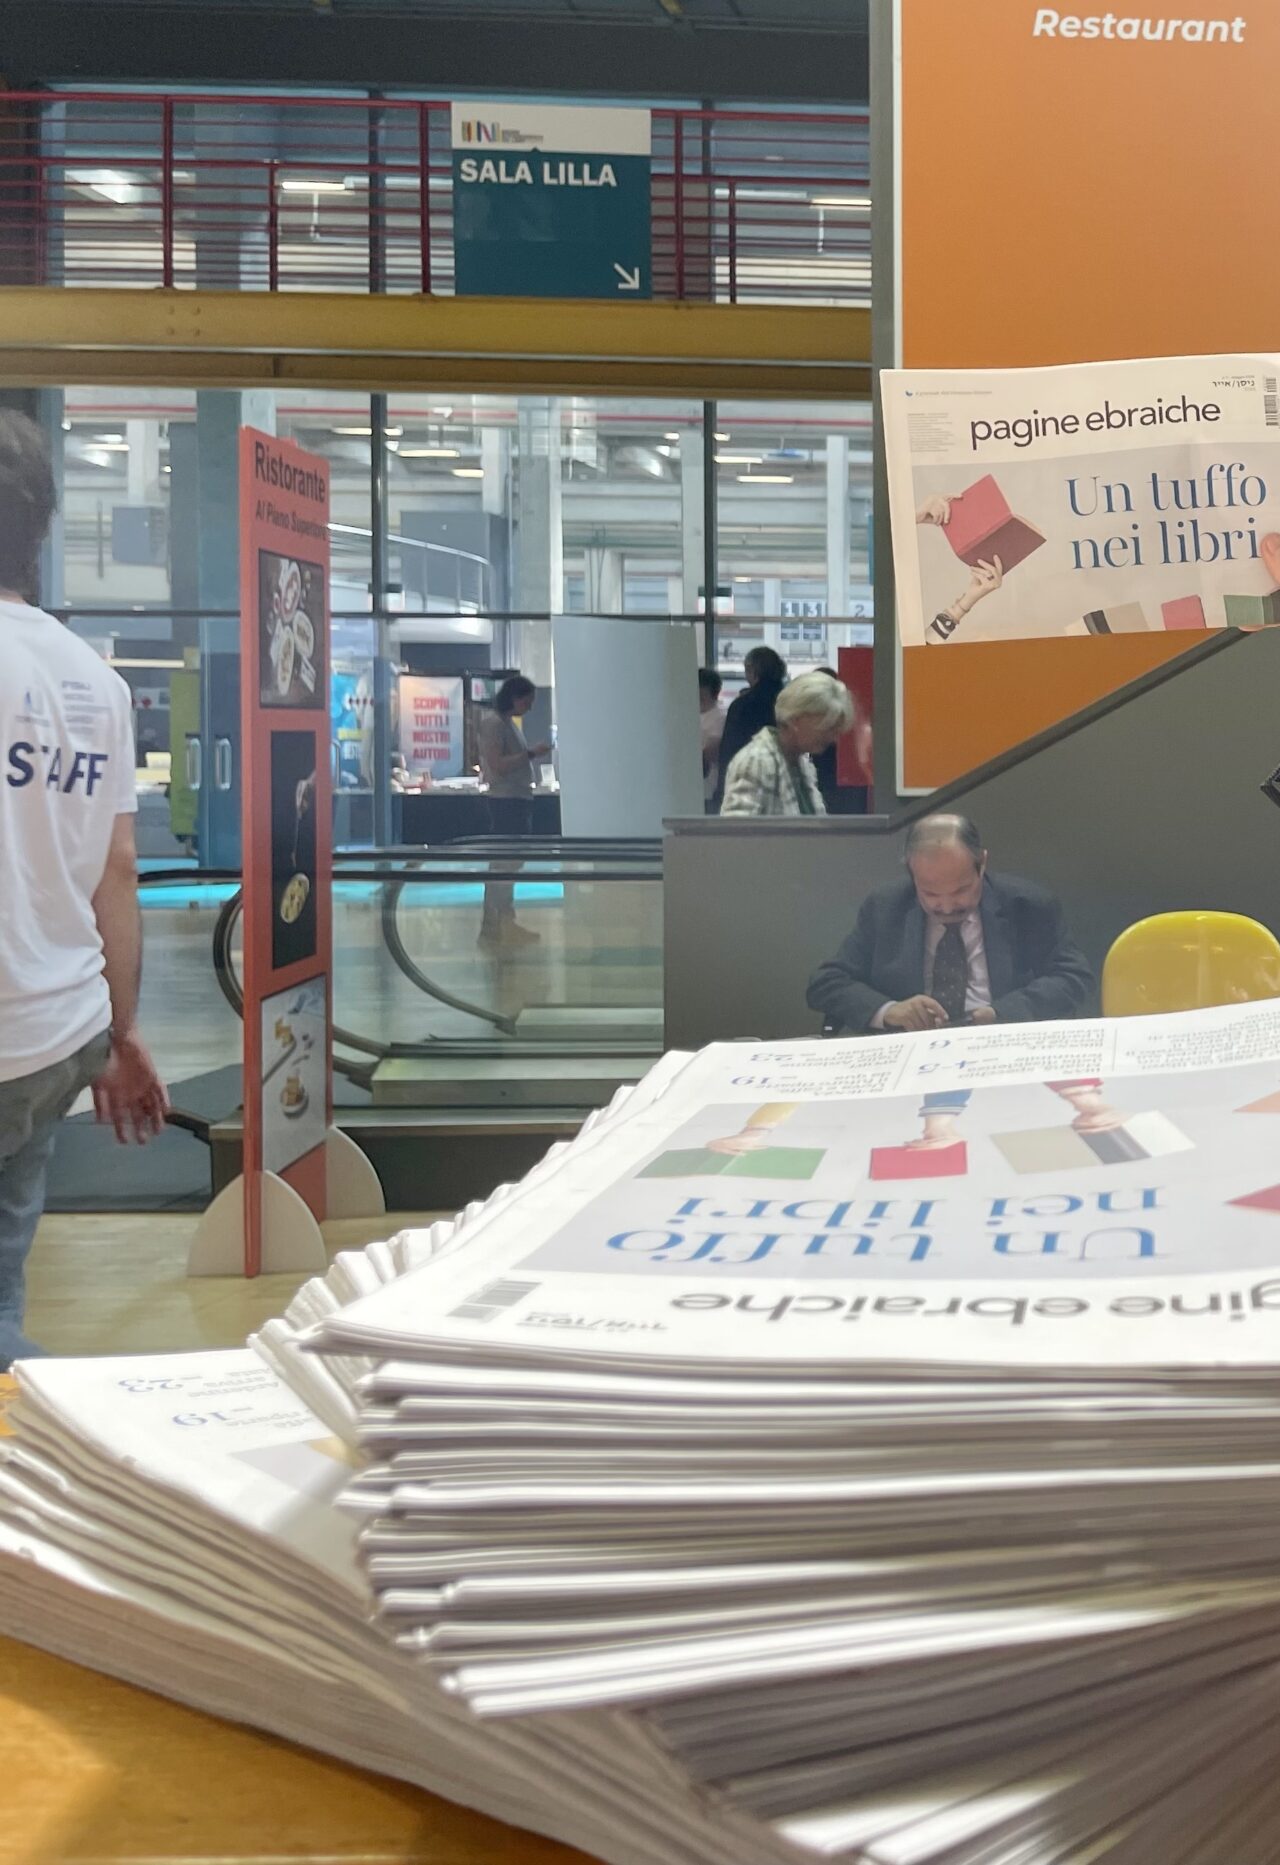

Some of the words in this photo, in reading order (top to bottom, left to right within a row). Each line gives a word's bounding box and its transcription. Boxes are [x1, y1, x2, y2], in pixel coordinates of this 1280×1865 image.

[1032, 8, 1247, 43] Restaurant
[460, 158, 533, 184] SALA
[543, 162, 617, 187] LILLA
[970, 408, 1080, 450] pagine
[1085, 395, 1221, 431] ebraiche
[255, 440, 326, 503] Ristorante
[1066, 475, 1134, 517] Un
[1147, 462, 1267, 511] tuffo
[1071, 523, 1143, 570] nei
[1158, 516, 1262, 564] libri
[666, 1197, 948, 1229] libri
[986, 1187, 1168, 1226] nei
[605, 1229, 938, 1263] tuffo
[993, 1227, 1171, 1260] Un
[670, 1291, 1090, 1325] ebraiche
[118, 1378, 184, 1393] 23
[171, 1410, 228, 1426] 19
